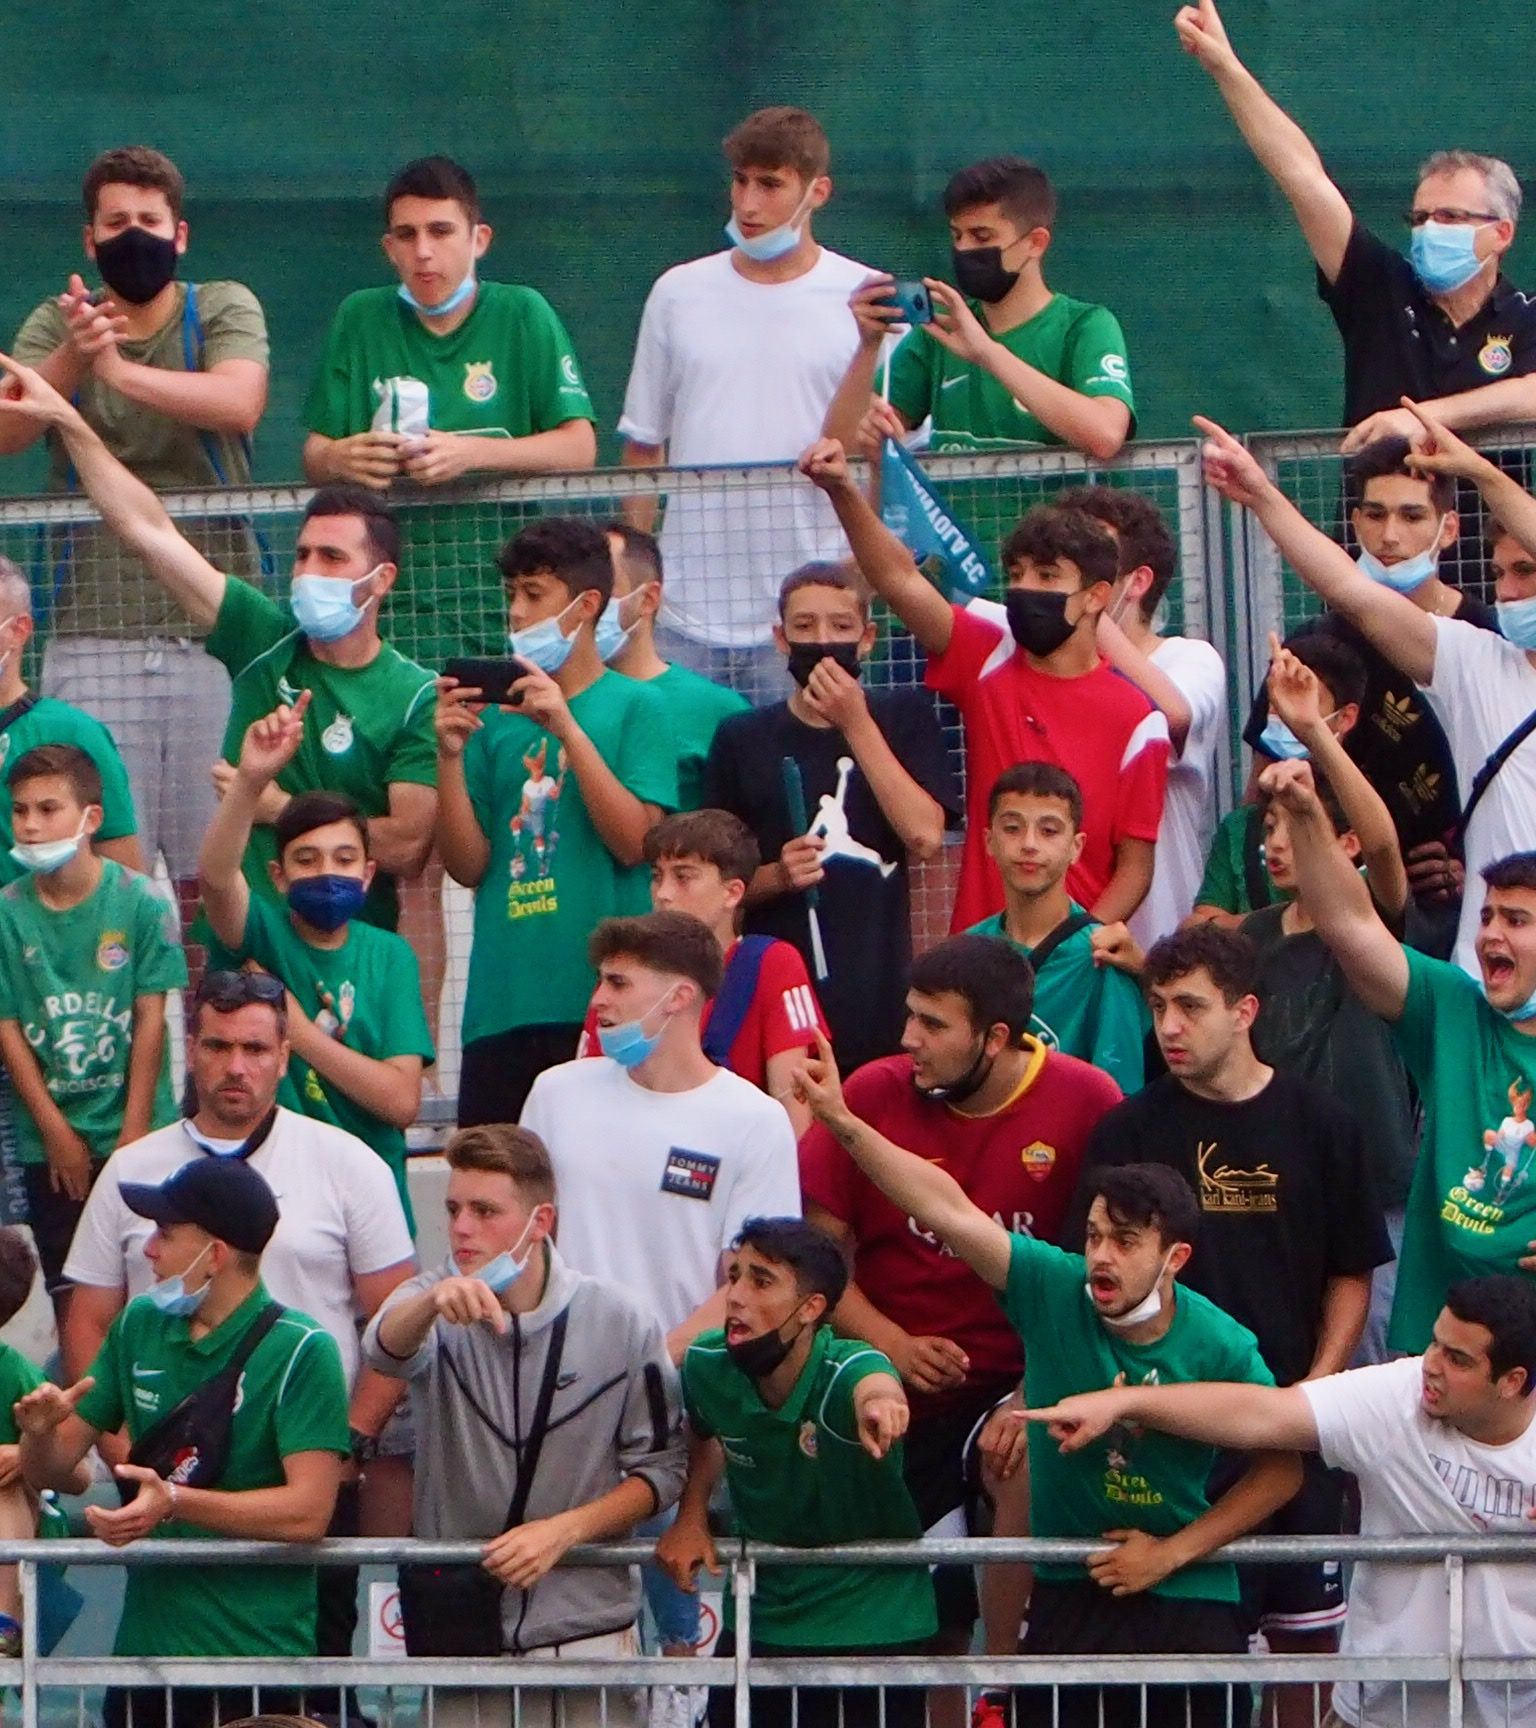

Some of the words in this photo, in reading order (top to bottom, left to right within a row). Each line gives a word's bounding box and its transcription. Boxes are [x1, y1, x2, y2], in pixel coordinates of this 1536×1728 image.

[670, 1156, 716, 1174] TOMMY
[669, 1175, 707, 1191] JEANS
[1449, 1186, 1503, 1220] Green
[1440, 1200, 1495, 1235] Devils
